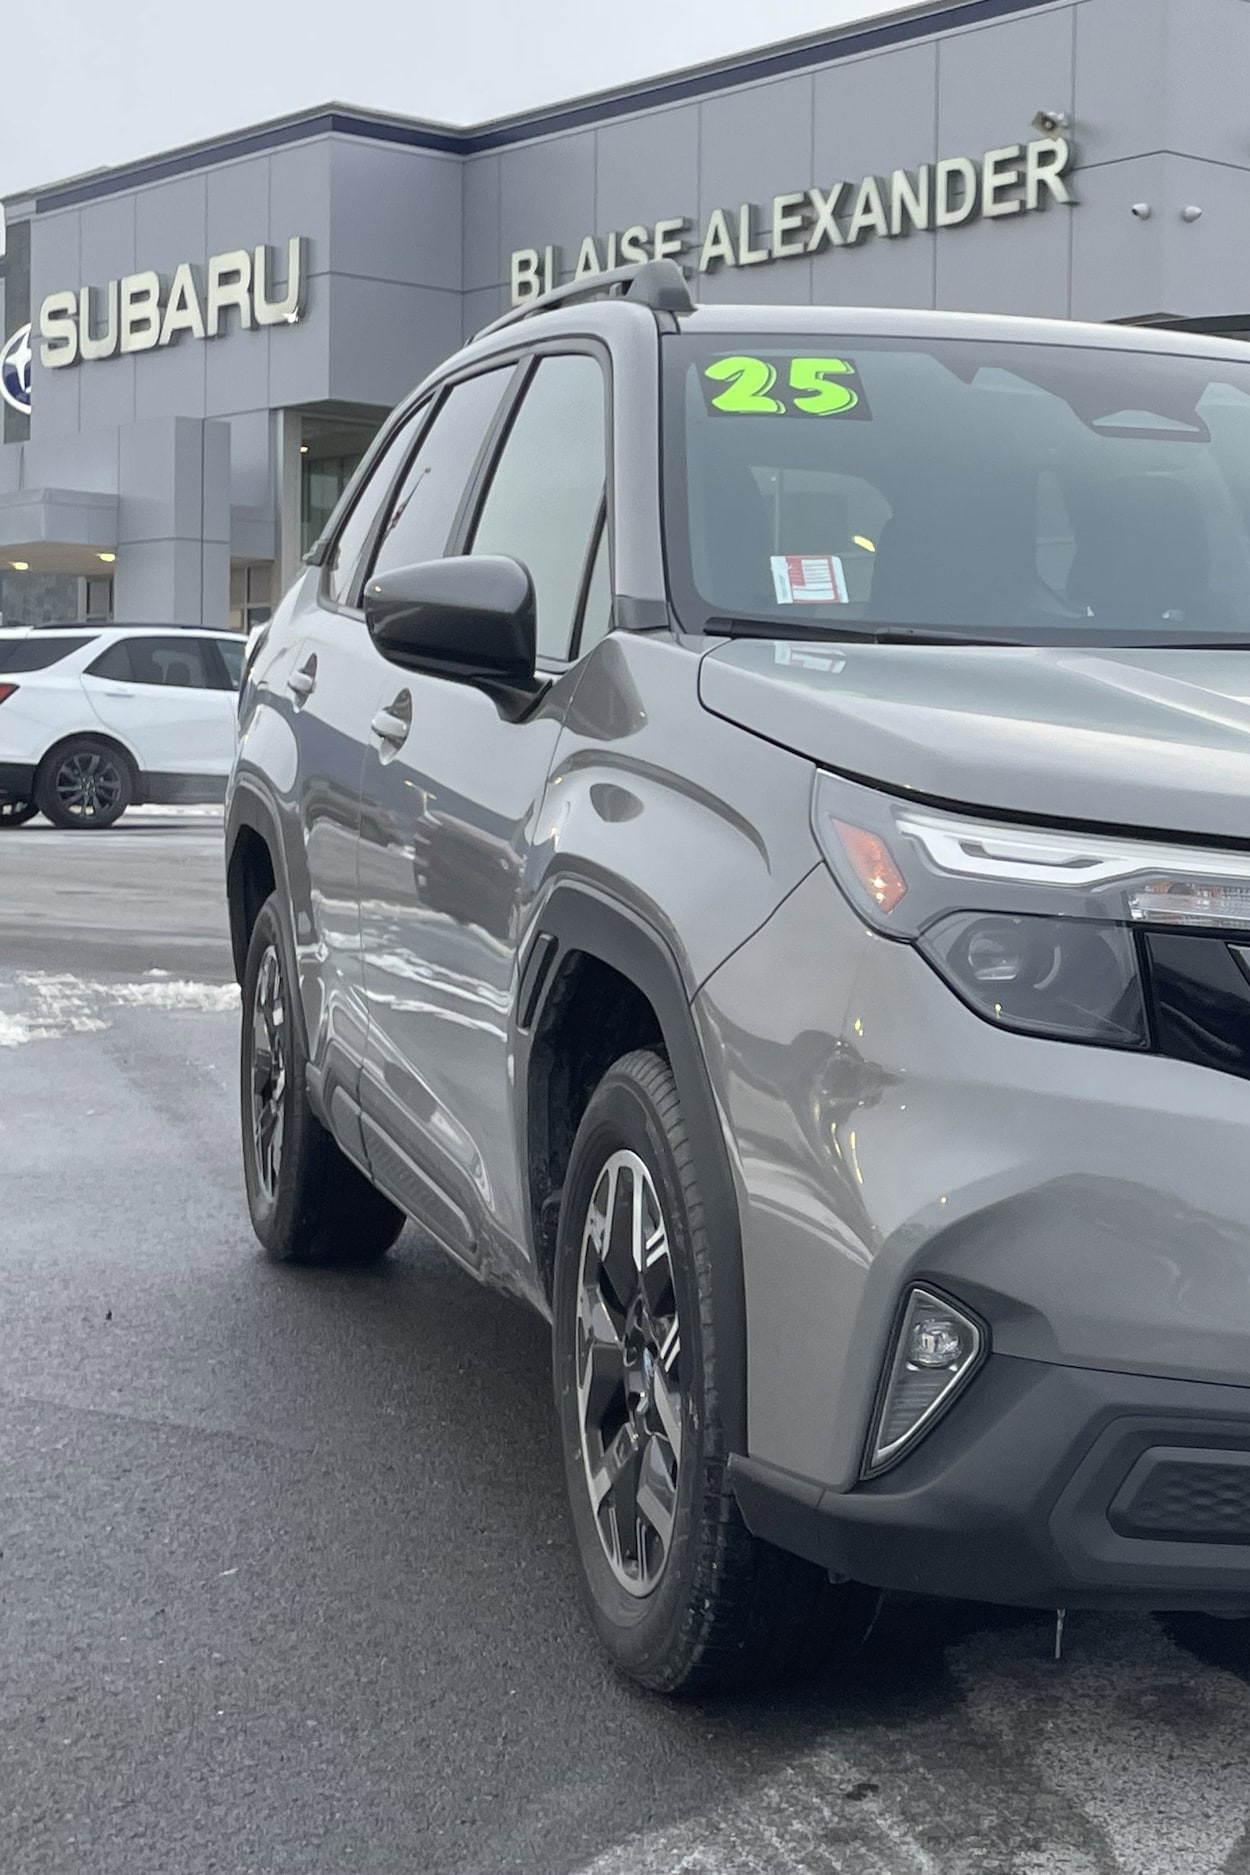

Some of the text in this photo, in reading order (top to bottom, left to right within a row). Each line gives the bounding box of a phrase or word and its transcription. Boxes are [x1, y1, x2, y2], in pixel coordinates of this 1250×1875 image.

[698, 137, 1070, 271] ALEXANDER
[39, 236, 302, 369] SUBARU
[704, 356, 858, 416] 25
